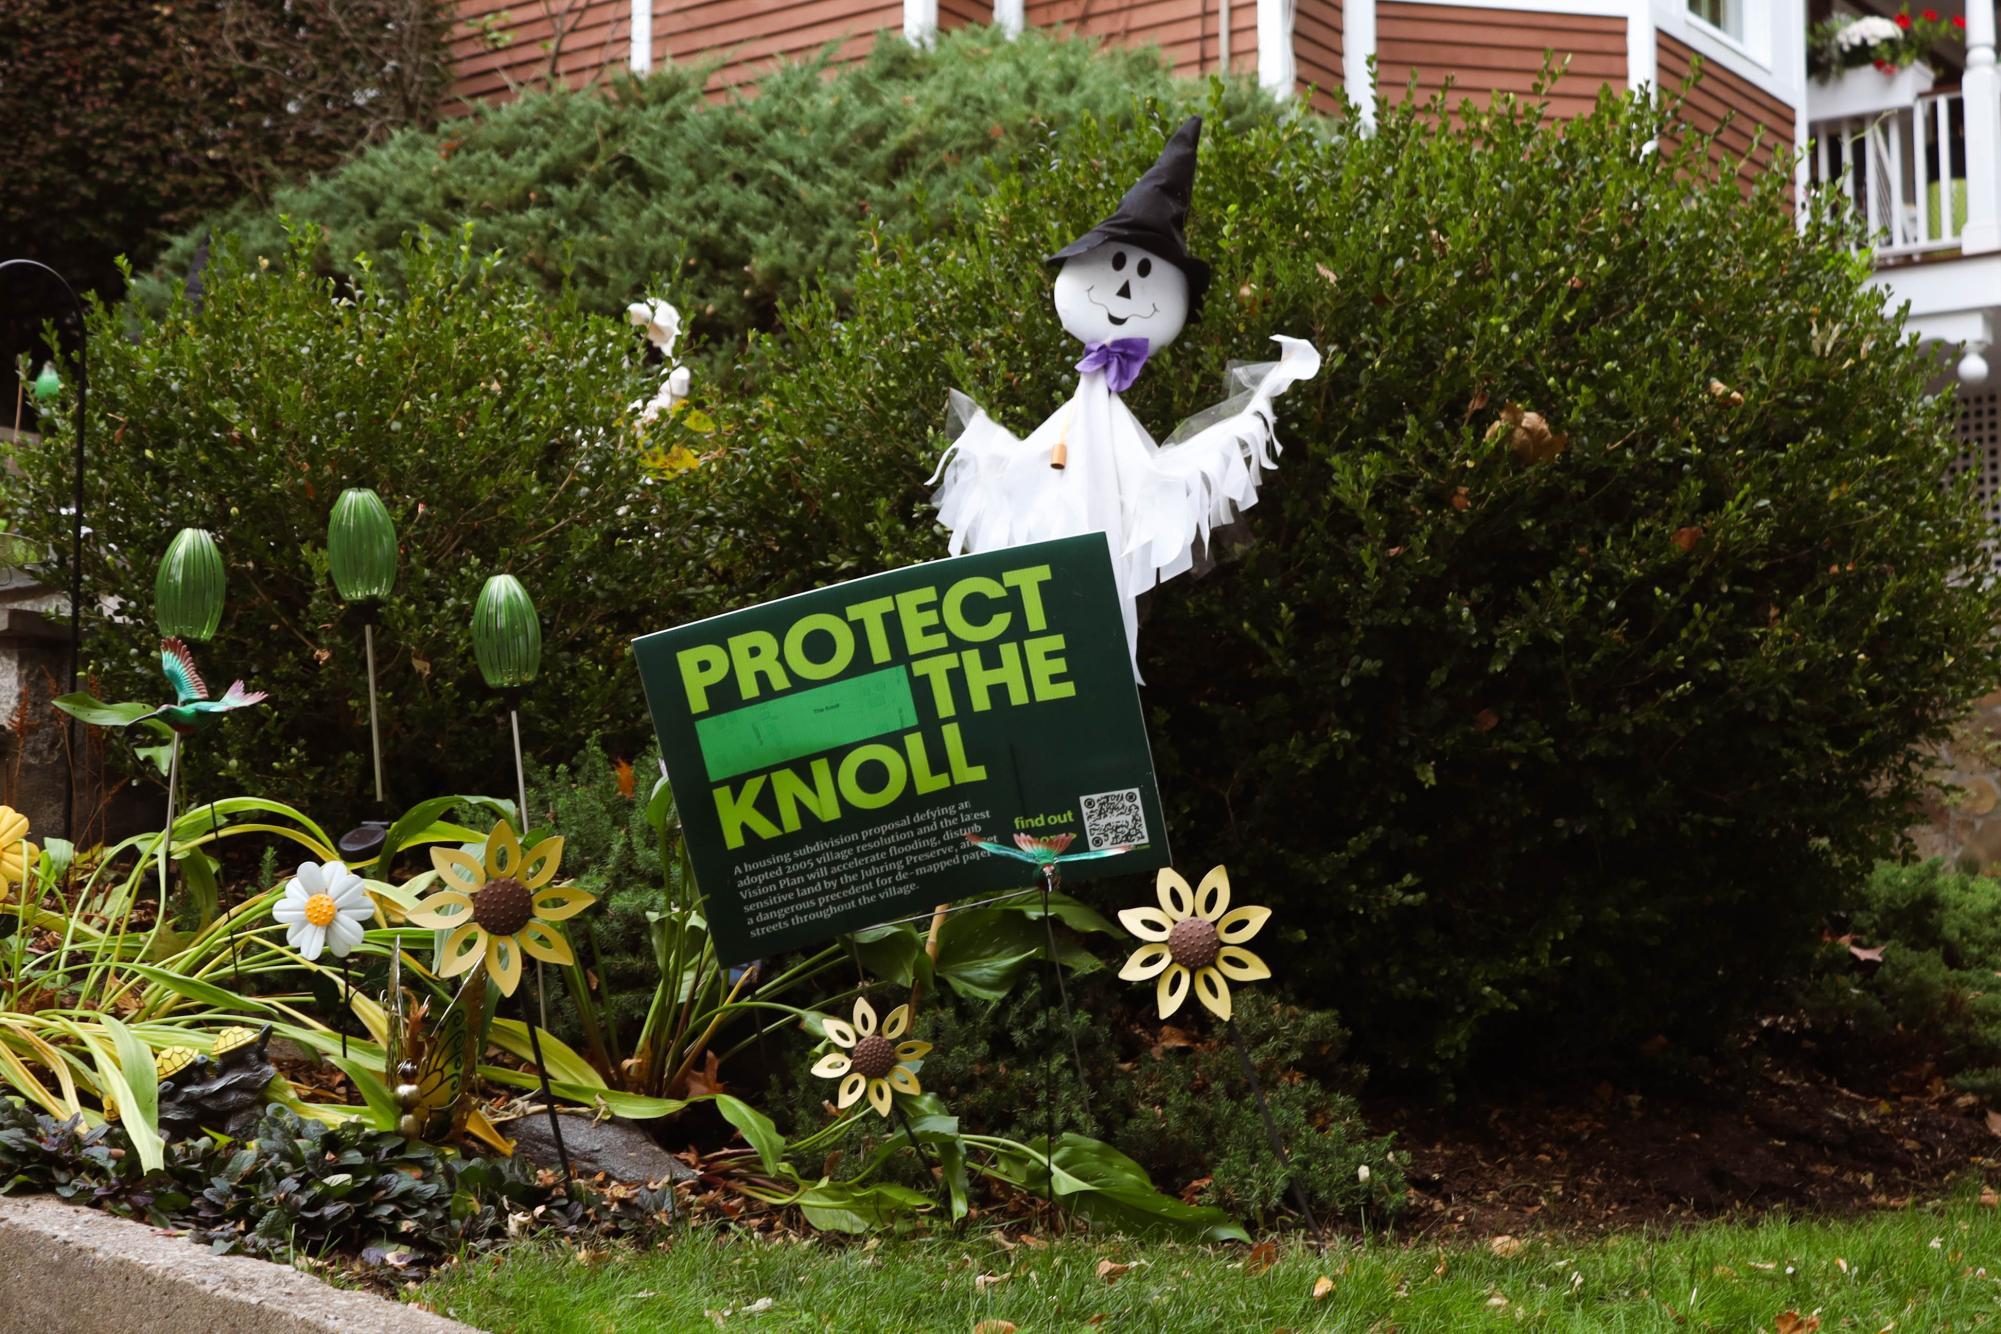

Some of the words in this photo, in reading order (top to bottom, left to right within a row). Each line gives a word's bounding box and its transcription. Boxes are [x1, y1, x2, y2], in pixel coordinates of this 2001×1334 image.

[676, 564, 1052, 714] PROTECT
[912, 633, 1076, 719] THE
[712, 722, 987, 850] KNOLL
[1014, 813, 1045, 830] find
[1047, 810, 1074, 825] out
[734, 865, 743, 876] A
[743, 852, 792, 872] housing
[793, 832, 859, 858] subdivision
[861, 815, 911, 841] proposal
[913, 804, 957, 823] defying
[737, 865, 783, 888] adopted
[785, 858, 814, 874] 2005
[815, 847, 853, 864] village
[856, 831, 914, 853] resolution
[916, 821, 937, 836] and
[940, 817, 959, 829] the
[739, 883, 777, 900] Vision
[779, 875, 805, 889] Plan
[806, 866, 828, 881] will
[830, 851, 887, 874] accelerate
[888, 836, 941, 856] flooding,
[743, 892, 794, 913] sensitive
[796, 881, 822, 897] land
[823, 879, 837, 890] by
[840, 873, 858, 885] the
[860, 859, 904, 880] Juhring
[905, 845, 958, 865] Preserve,
[747, 917, 754, 925] a
[756, 899, 816, 923] dangerous
[817, 881, 874, 907] precedent
[876, 875, 893, 888] for
[895, 854, 960, 881] de-mapped
[750, 920, 789, 938] streets
[791, 900, 856, 926] throughout
[858, 895, 877, 906] the
[879, 882, 919, 899] village.
